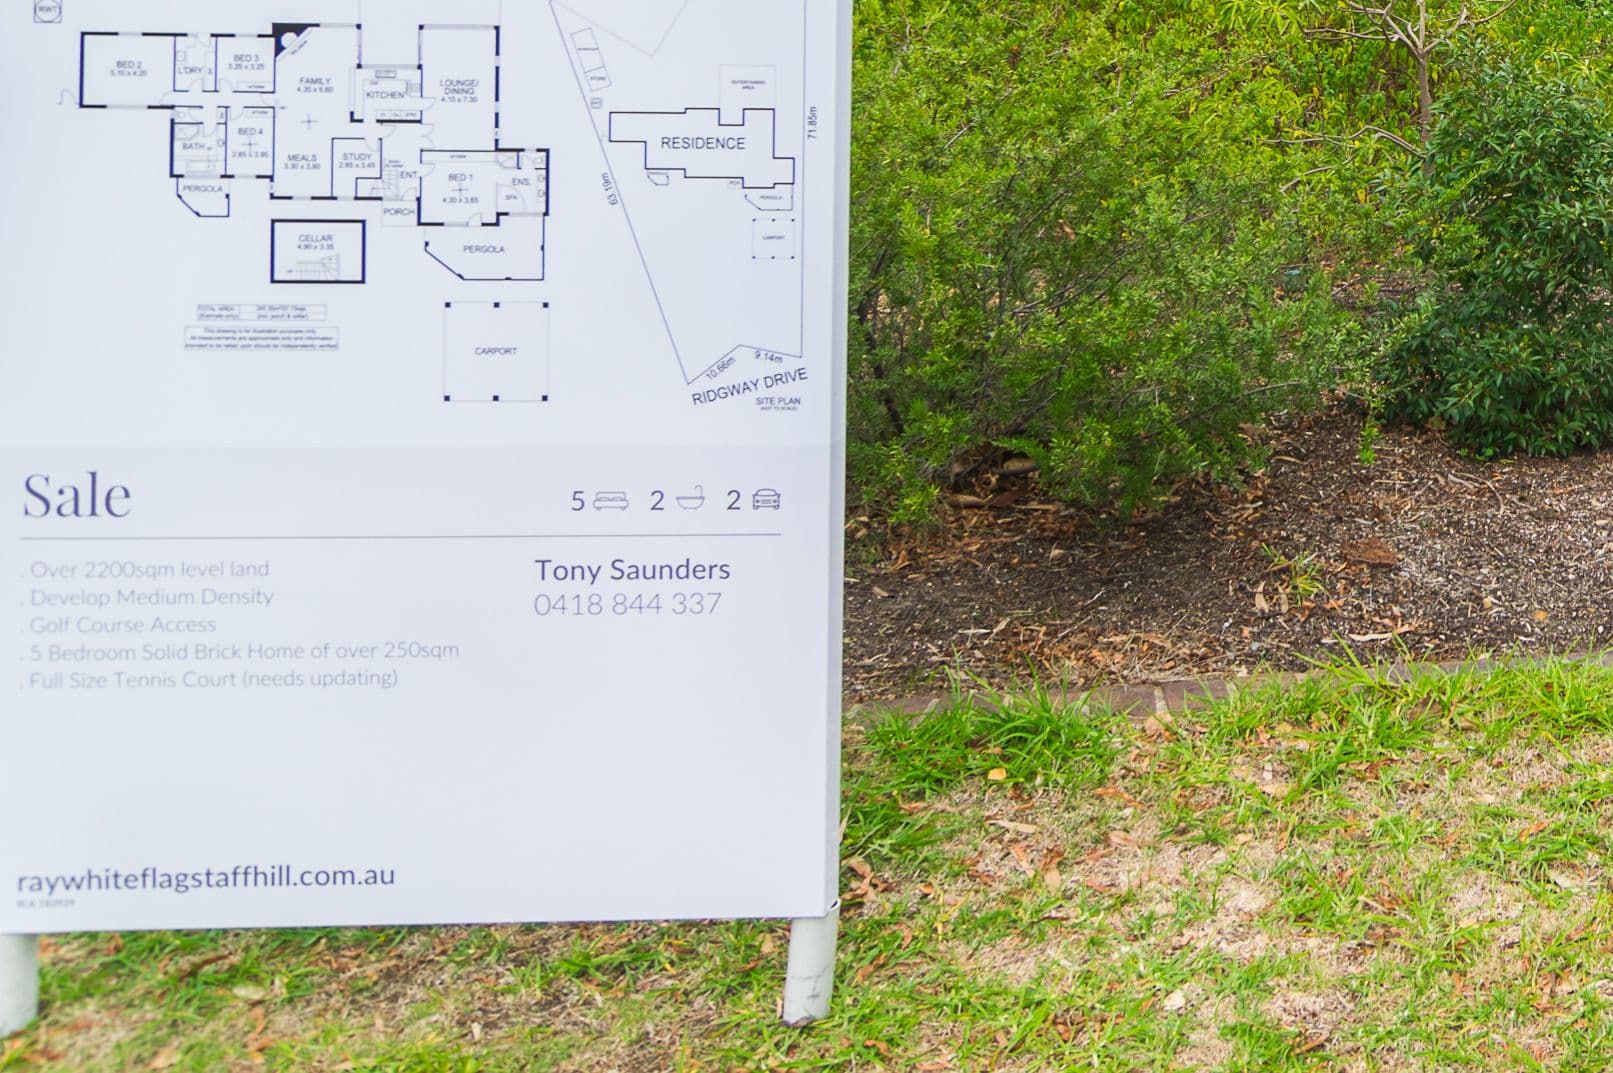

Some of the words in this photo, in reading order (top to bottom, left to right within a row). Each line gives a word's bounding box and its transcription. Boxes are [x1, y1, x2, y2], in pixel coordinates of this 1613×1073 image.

[234, 54, 253, 62] BED
[116, 60, 135, 69] BED
[299, 77, 332, 86] FAMILY
[366, 91, 405, 99] KITCHEN
[444, 88, 474, 97] DINING
[238, 128, 257, 136] BED
[182, 142, 204, 151] BATH
[661, 136, 746, 150] RESIDENCE
[288, 154, 317, 163] MEALS
[343, 152, 372, 161] STUDY
[448, 173, 466, 182] BED
[183, 184, 223, 193] PERGOLA
[383, 207, 415, 216] PORCH
[298, 234, 333, 243] CELLAR
[463, 245, 505, 254] PERGOLA
[474, 347, 518, 356] CARPORT
[692, 378, 760, 405] RIDGWAY
[764, 367, 808, 389] DRIVE
[756, 397, 775, 406] SITE
[778, 397, 801, 405] PLAN
[25, 470, 131, 518] Sale
[571, 490, 585, 511] 5
[650, 490, 665, 511] 2
[727, 490, 742, 510] 2
[30, 561, 78, 578] Over
[85, 561, 175, 581] 2200sqm
[181, 560, 224, 578] level
[231, 560, 269, 577] land
[534, 559, 602, 585] Tony
[610, 558, 731, 581] Saunders
[31, 588, 110, 608] Develop
[117, 588, 195, 606] Medium
[202, 587, 275, 607] Density
[534, 594, 603, 615] 0418
[612, 593, 663, 615] 844
[672, 592, 722, 614] 337
[30, 616, 71, 633] Golf
[77, 616, 144, 633] Course
[151, 616, 217, 633] Access
[31, 644, 42, 662] 5
[49, 644, 136, 662] Bedroom
[143, 643, 188, 661] Solid
[195, 643, 241, 660] Brick
[248, 642, 304, 659] Home
[310, 641, 330, 658] of
[336, 646, 378, 658] over
[384, 641, 459, 661] 250sqm
[30, 671, 64, 688] Full
[69, 671, 107, 688] Size
[113, 671, 177, 688] Tennis
[182, 671, 236, 688] Court
[243, 669, 304, 688] (needs
[310, 668, 398, 689] updating)
[17, 864, 395, 895] raywhiteflagstaffhill.com.au
